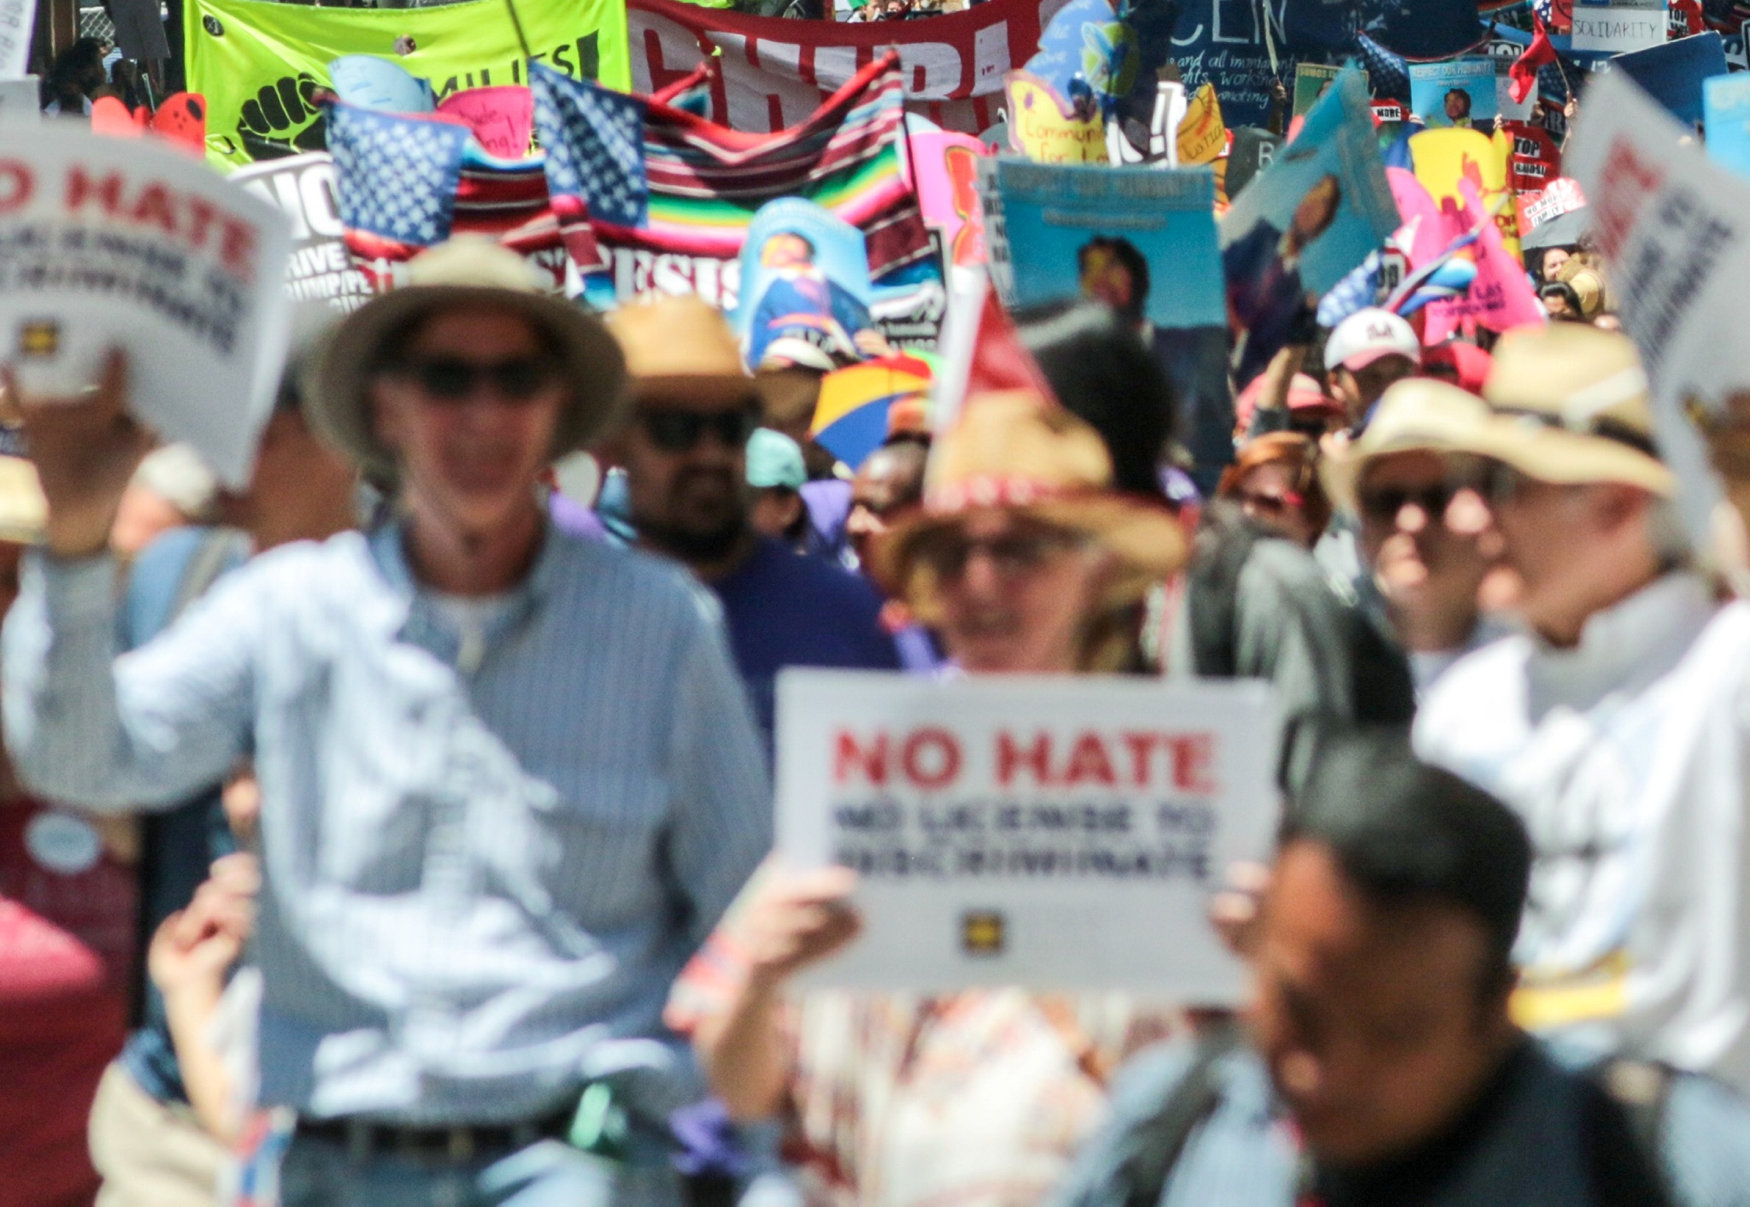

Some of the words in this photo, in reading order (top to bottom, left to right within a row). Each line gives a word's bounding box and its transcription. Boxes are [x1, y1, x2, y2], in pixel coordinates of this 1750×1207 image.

[1574, 20, 1657, 39] SOLIDARITY
[1208, 49, 1228, 68] all
[1515, 137, 1541, 158] TOP
[65, 166, 262, 285] HATE
[286, 245, 347, 279] RIVE
[832, 724, 964, 790] NO
[992, 726, 1219, 793] HATE
